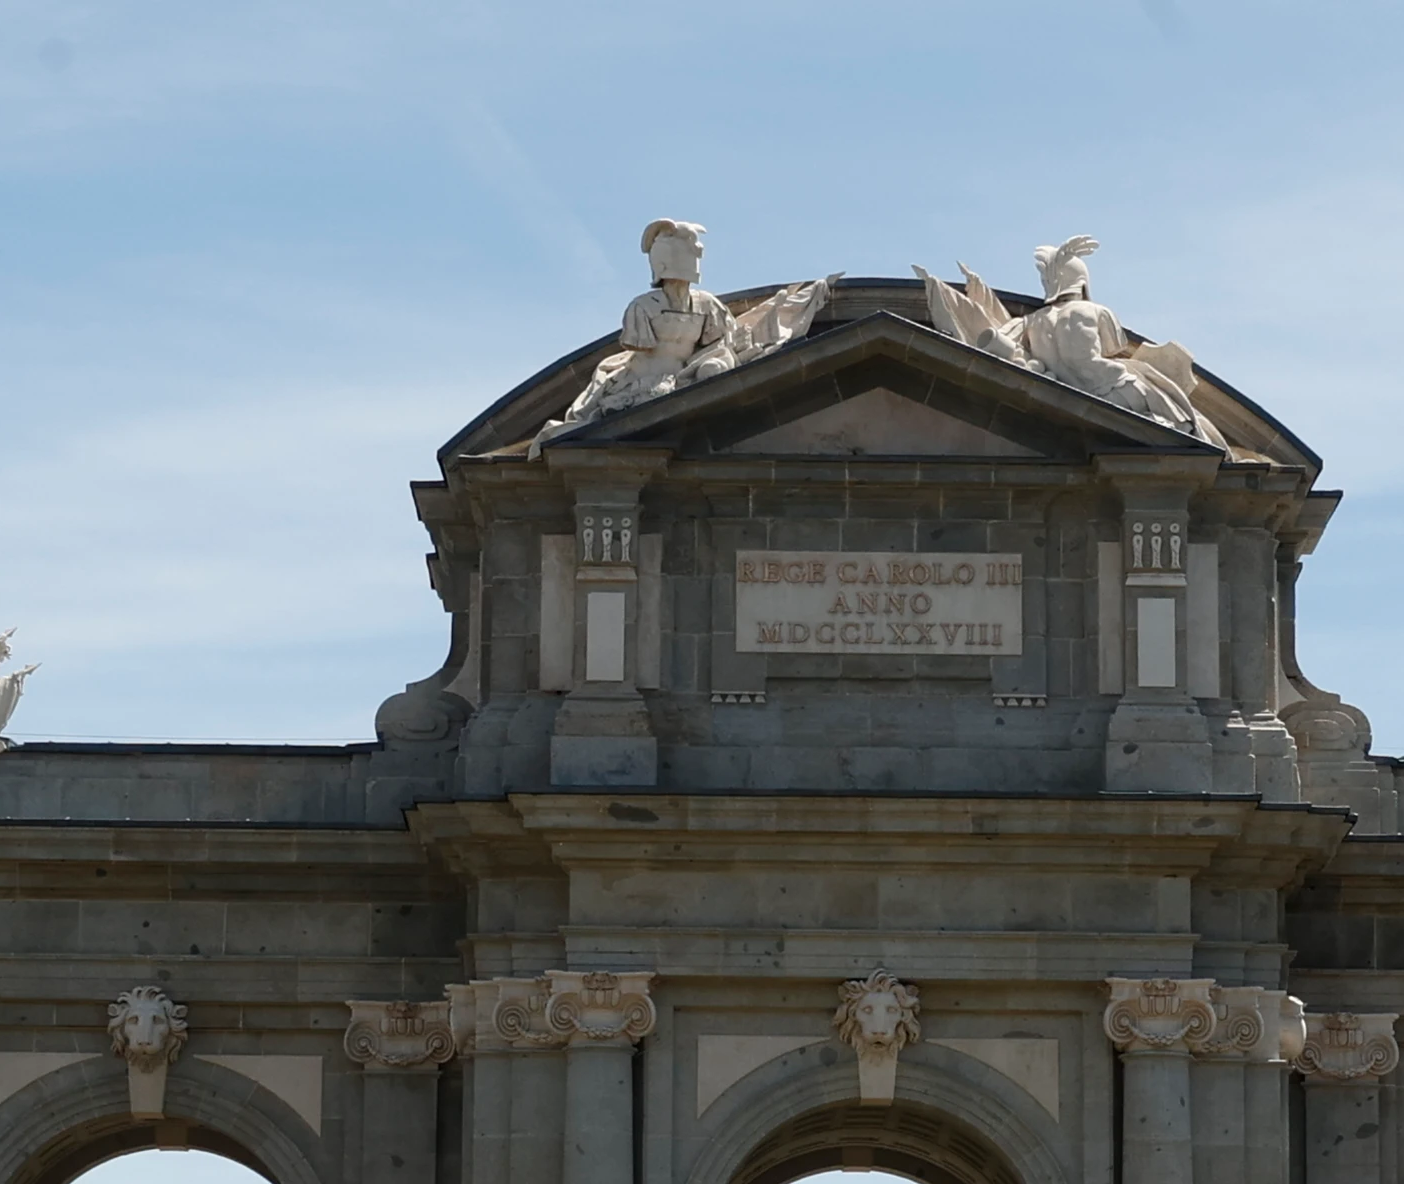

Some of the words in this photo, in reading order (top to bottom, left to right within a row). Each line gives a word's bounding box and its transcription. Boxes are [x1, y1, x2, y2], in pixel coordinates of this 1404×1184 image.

[737, 561, 826, 583] REGE
[837, 562, 975, 585] CAROLO
[986, 563, 1022, 586] III
[828, 592, 932, 615] ANNO
[757, 621, 1003, 646] MDCCLXXVIII
